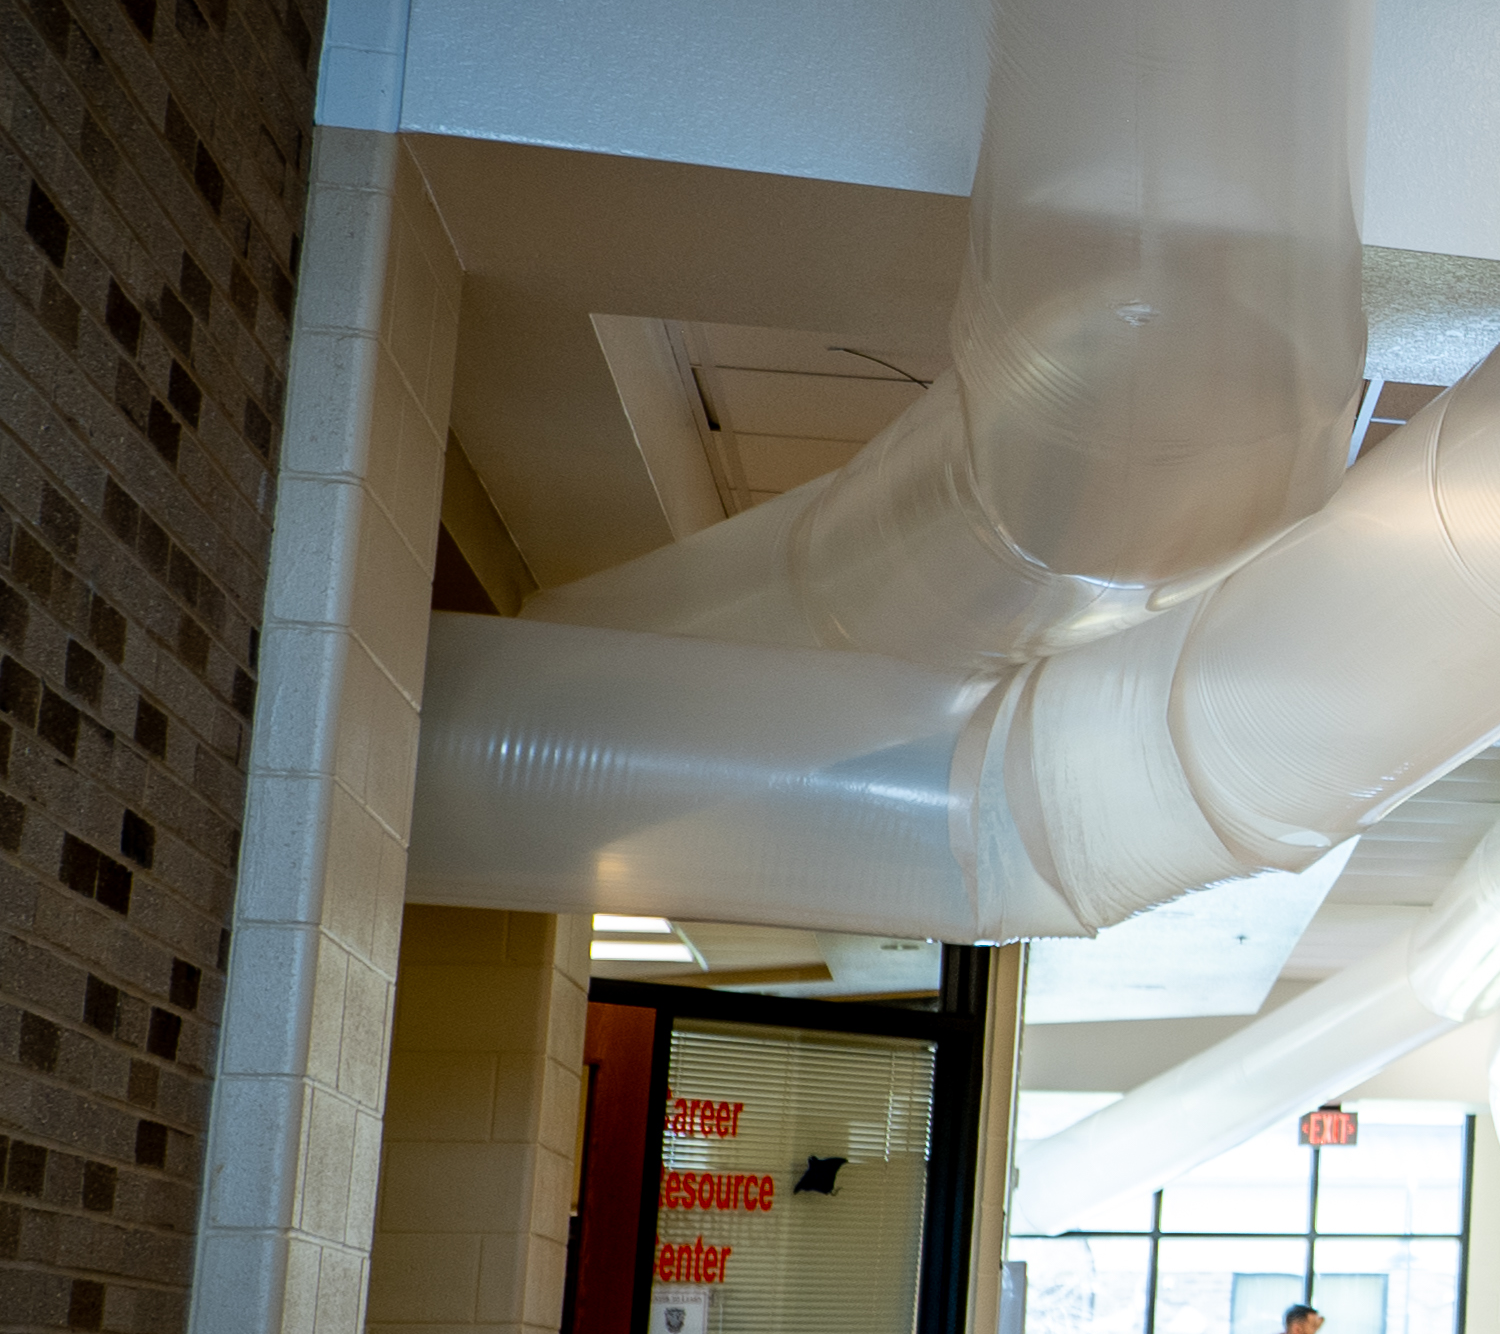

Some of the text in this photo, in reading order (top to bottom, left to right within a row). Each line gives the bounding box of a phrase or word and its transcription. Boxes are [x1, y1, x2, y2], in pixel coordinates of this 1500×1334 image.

[666, 1087, 744, 1138] areer
[1309, 1113, 1350, 1145] EXIT
[659, 1164, 774, 1212] esource
[653, 1233, 732, 1283] enter
